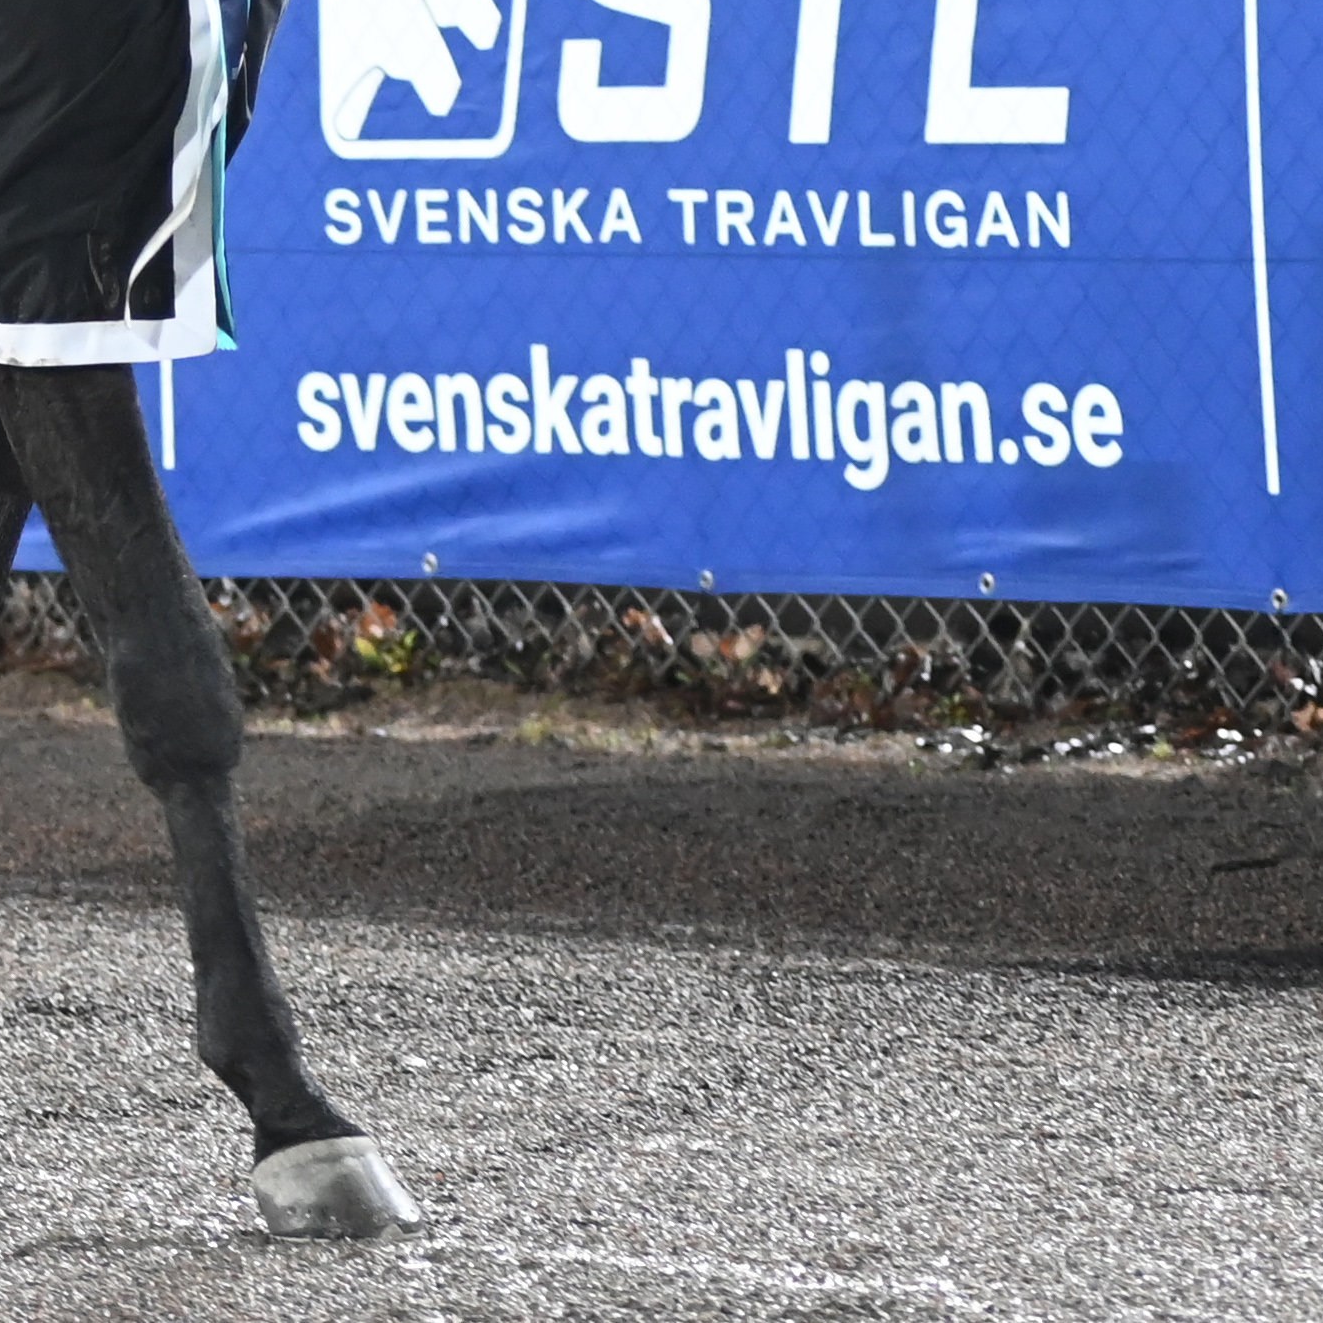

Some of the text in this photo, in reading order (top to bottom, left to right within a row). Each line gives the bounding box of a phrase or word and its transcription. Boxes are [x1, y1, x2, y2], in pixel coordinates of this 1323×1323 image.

[324, 186, 1071, 249] SVENSKA TRAVLIGAN
[297, 343, 1124, 491] svenskatravligan.se
